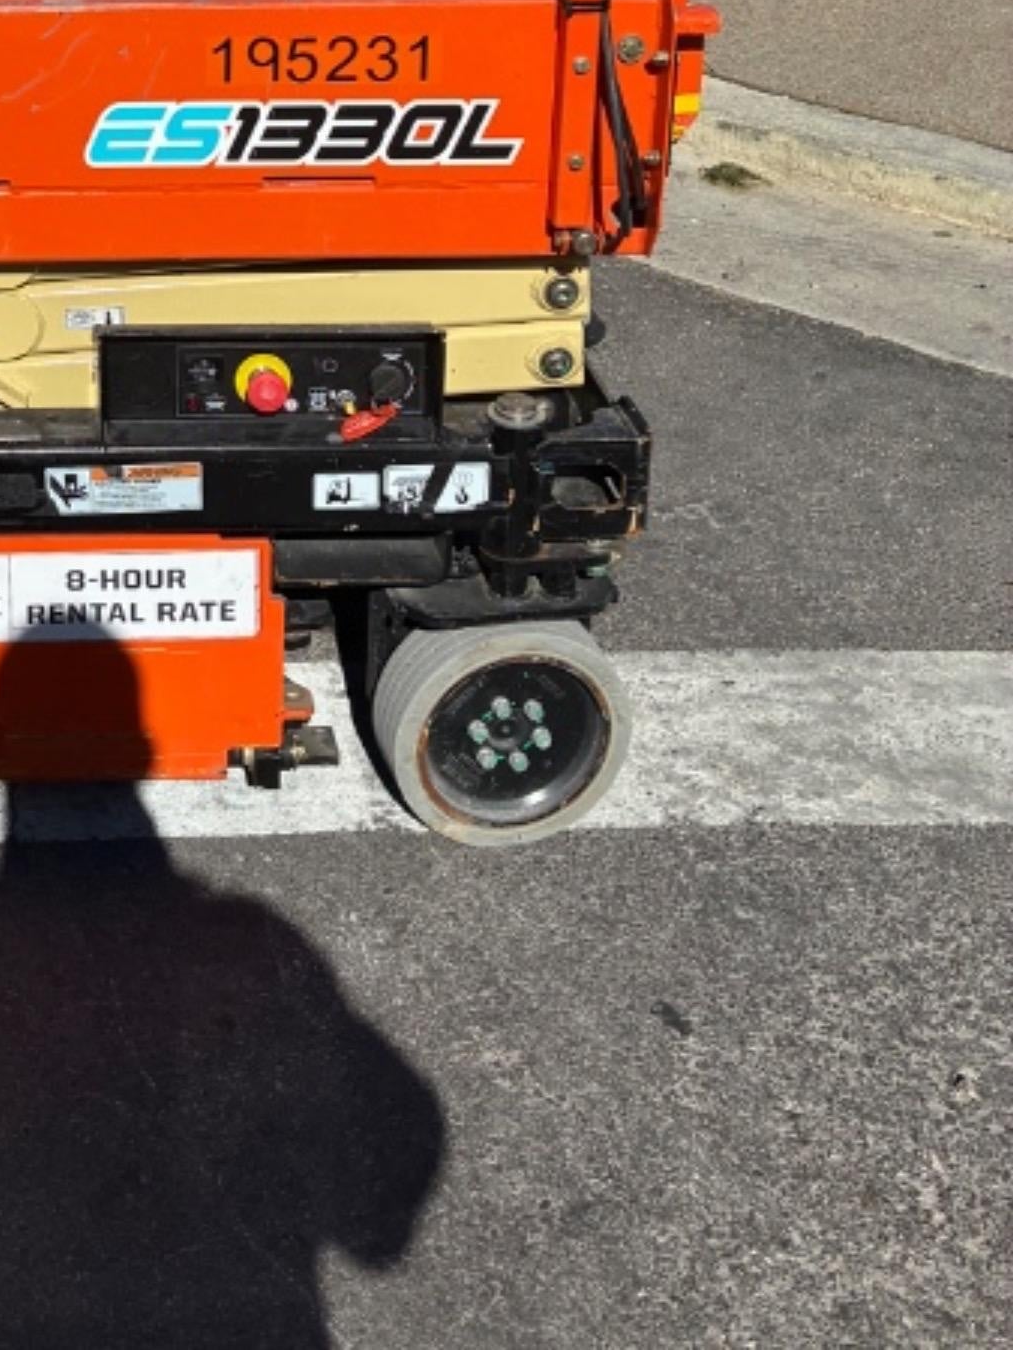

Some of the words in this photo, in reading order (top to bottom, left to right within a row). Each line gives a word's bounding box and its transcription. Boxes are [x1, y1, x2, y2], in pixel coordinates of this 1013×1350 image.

[211, 35, 431, 83] 195231
[89, 104, 516, 163] ES1330L
[64, 568, 187, 591] 8-HOUR
[25, 603, 144, 626] RENTAL
[157, 599, 236, 622] RATE
